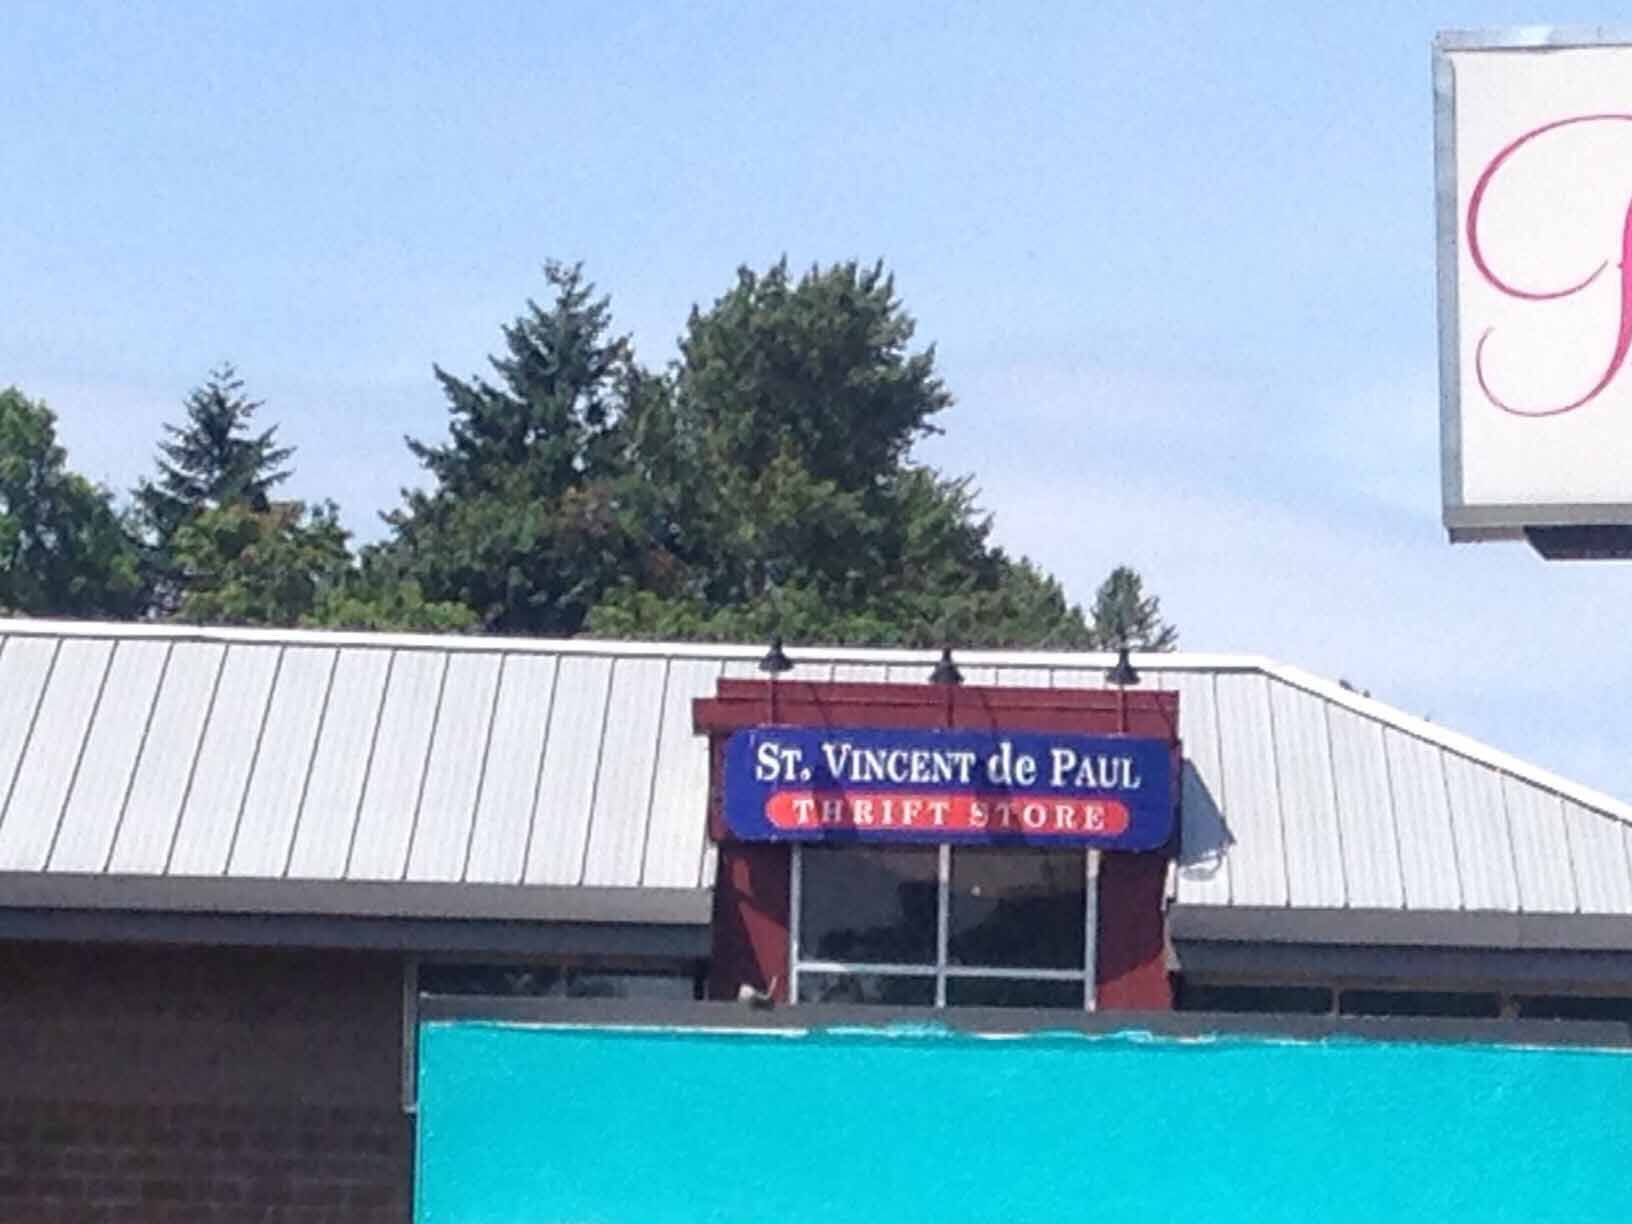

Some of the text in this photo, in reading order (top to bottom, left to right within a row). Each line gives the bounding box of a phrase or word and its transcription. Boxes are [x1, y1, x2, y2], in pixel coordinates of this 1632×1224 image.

[986, 741, 1037, 786] de
[791, 798, 1106, 831] THRIFT STORE
